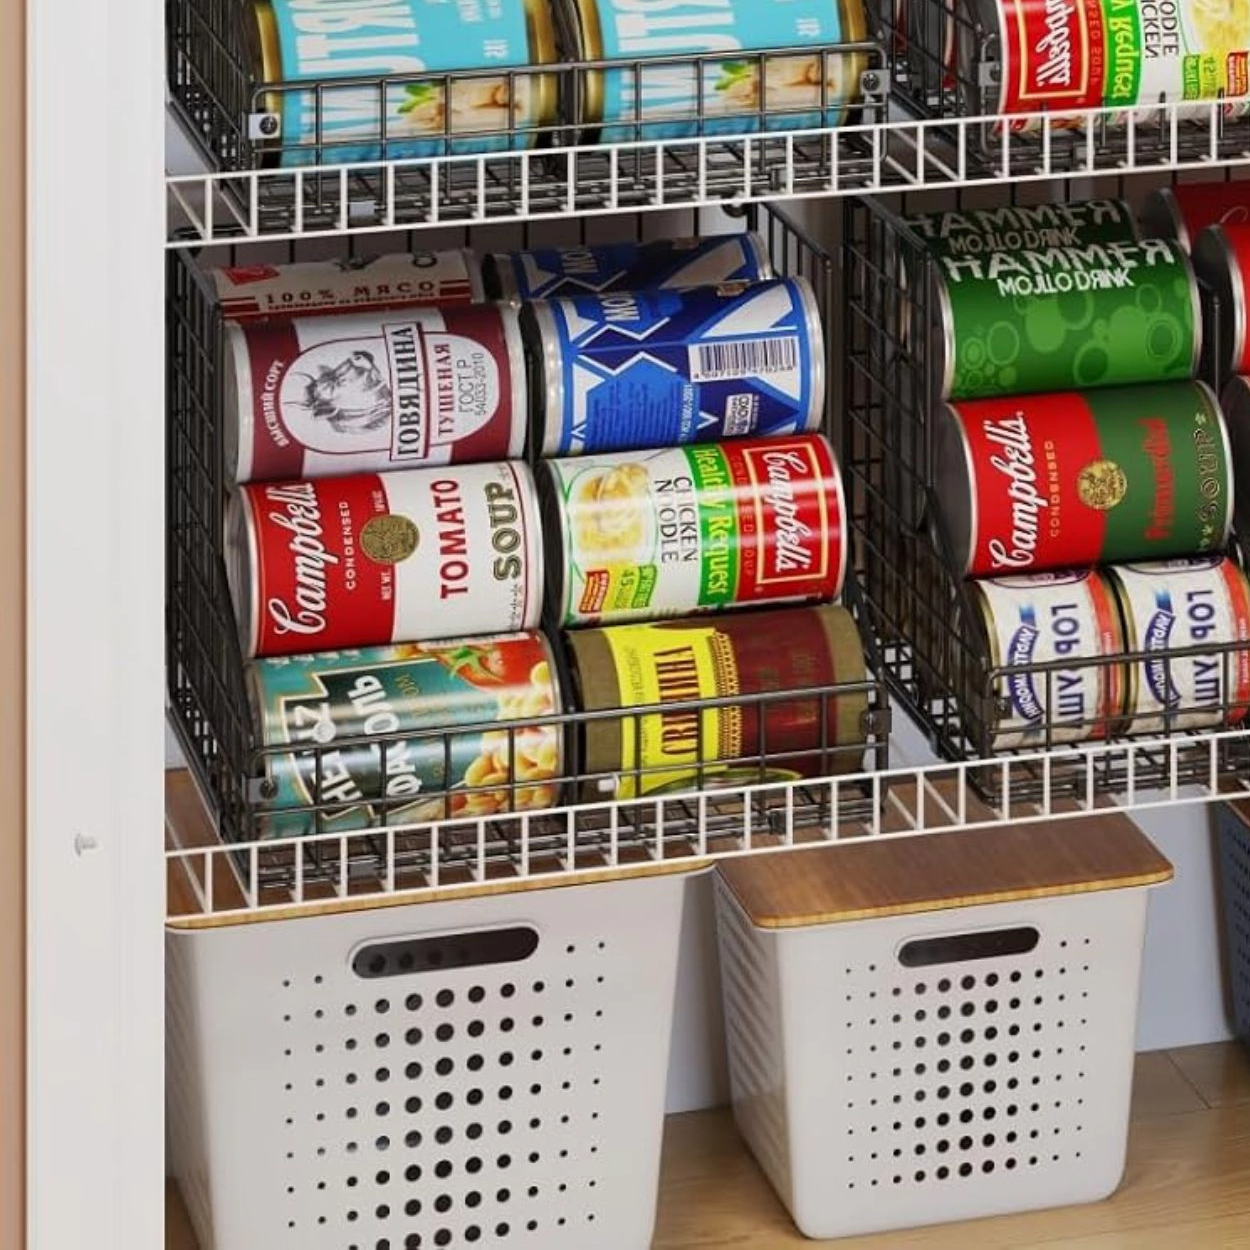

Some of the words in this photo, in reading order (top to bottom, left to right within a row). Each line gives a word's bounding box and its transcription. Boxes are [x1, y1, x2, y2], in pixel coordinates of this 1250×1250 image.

[391, 325, 422, 457] ГОВЯДИНА
[433, 343, 456, 438] ТУШЕНАЯ
[458, 368, 475, 414] ГОСТ
[484, 482, 522, 582] SOUP
[672, 476, 698, 563] CHICKEN
[1044, 440, 1061, 539] CONDENSED
[339, 501, 357, 591] CONDENSED
[430, 479, 470, 600] TOMATO
[708, 514, 730, 596] Request
